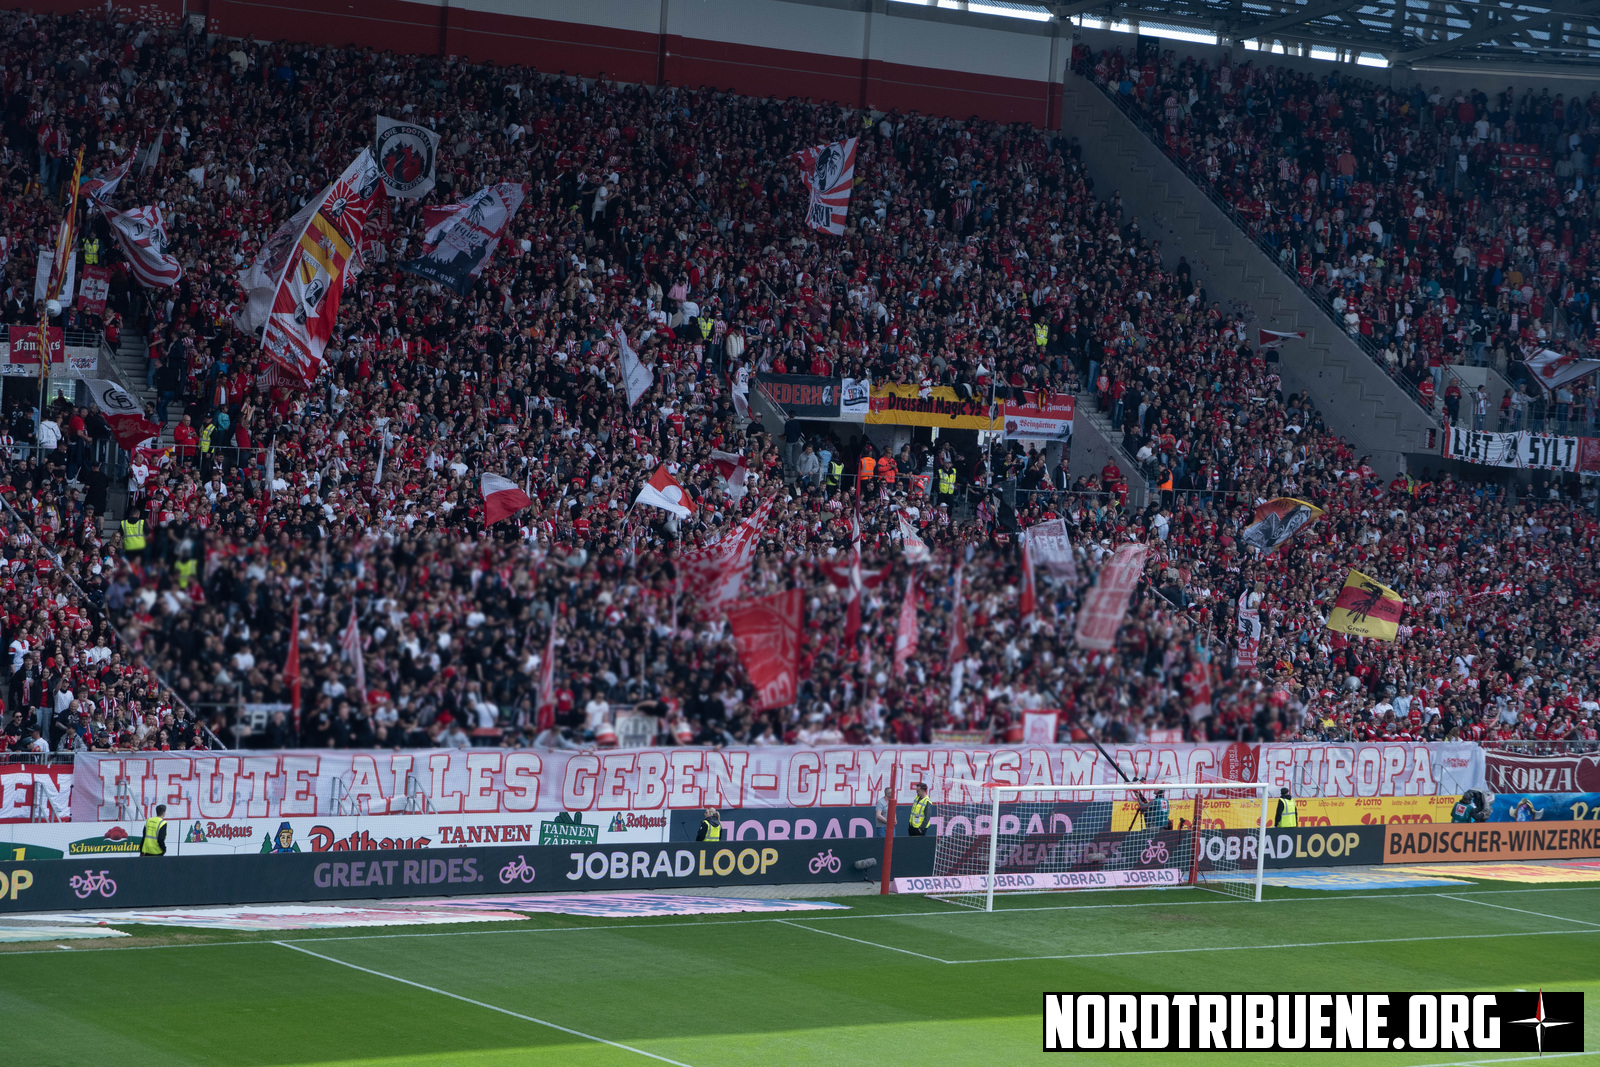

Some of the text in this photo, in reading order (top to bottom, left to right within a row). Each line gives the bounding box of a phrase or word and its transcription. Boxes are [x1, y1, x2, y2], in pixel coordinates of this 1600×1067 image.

[381, 127, 431, 151] LOVE FOOTBALL
[379, 171, 397, 188] HATE
[888, 391, 933, 413] Dreisam
[936, 396, 966, 419] Magic
[1529, 437, 1575, 467] SYLT
[98, 754, 321, 822] HEUTE
[342, 751, 543, 816] ALLES
[1114, 747, 1222, 802] NAC
[1266, 744, 1439, 800] EUROPA
[1498, 764, 1572, 792] FORZA
[1210, 801, 1231, 809] LOTTO
[1363, 798, 1382, 806] LOTTO
[1436, 797, 1455, 805] LOTTO
[625, 812, 667, 829] Rothaus
[206, 821, 253, 841] Rothaus
[438, 824, 533, 844] TANNEN
[543, 823, 596, 838] TANNEN
[996, 843, 1059, 867] GREAT
[314, 858, 484, 888] GREAT RIDES.
[980, 874, 1035, 888] JOBRAD
[1052, 873, 1107, 886] JOBRAD
[1123, 869, 1175, 883] JOBRAD
[906, 876, 962, 891] JOBRAD
